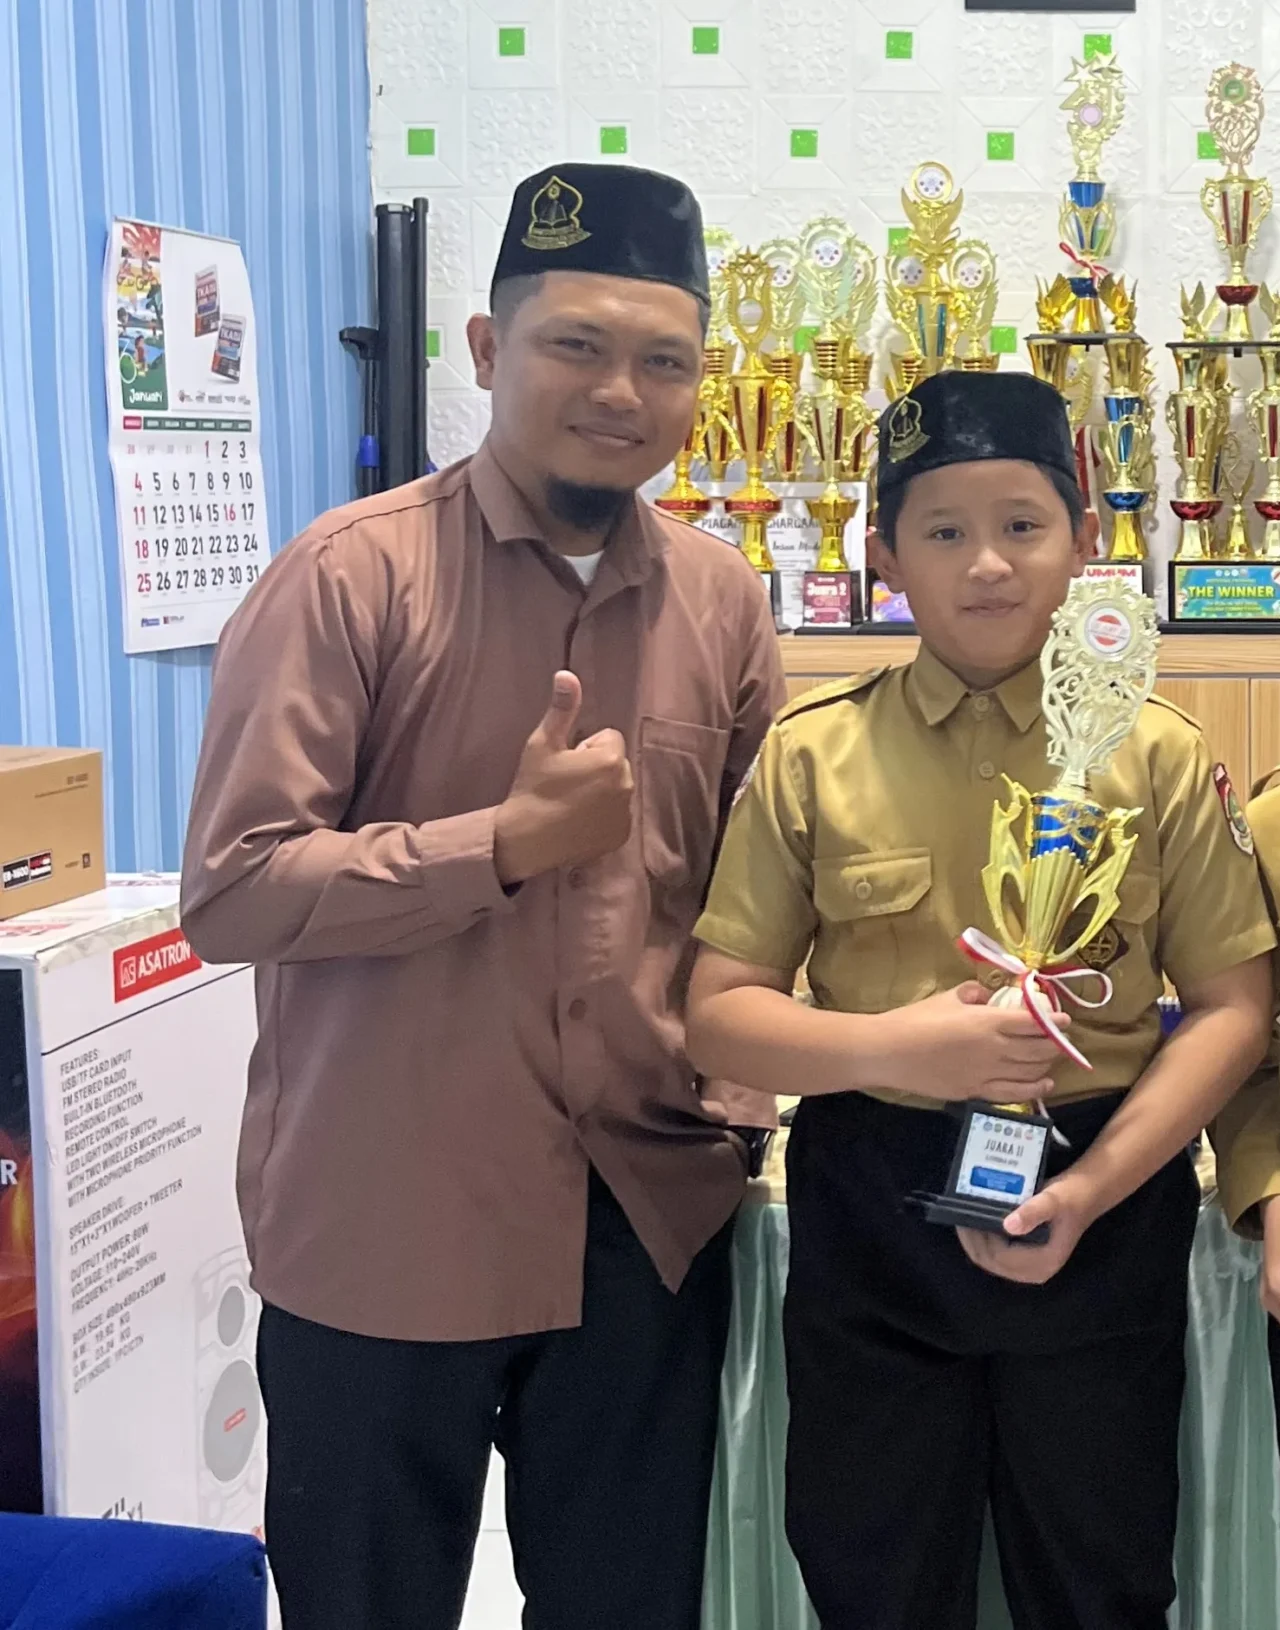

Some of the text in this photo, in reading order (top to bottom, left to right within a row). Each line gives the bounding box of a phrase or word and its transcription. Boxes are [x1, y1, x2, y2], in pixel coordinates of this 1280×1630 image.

[204, 440, 210, 459] 1
[221, 440, 229, 459] 2
[239, 440, 247, 459] 3
[134, 471, 253, 492] 4 5 6 7 8 9 10
[133, 502, 255, 526] 11 12 13 14 15 16 17
[135, 533, 258, 560] 18 19 20 21 22 23 24
[137, 564, 260, 593] 25 26 27 28 29 30 31
[839, 582, 848, 596] 2
[1188, 585, 1275, 598] THE WINNER
[138, 940, 191, 979] ASATRON
[89, 1059, 110, 1080] CARD
[111, 1048, 132, 1069] INPUT
[62, 1068, 127, 1110] FM STEREO RADIO
[94, 1079, 137, 1110] BLUETOOTH
[64, 1091, 144, 1141] RECORDING FUNCTION
[65, 1115, 129, 1158] REMOTE CONTROL
[66, 1158, 80, 1176] LED
[80, 1145, 101, 1168] LIGHT
[129, 1115, 158, 1140] SWITCH
[984, 1139, 1025, 1157] JUARA II
[67, 1116, 186, 1192] WITH TWO WIRELESS MICROPHONE
[68, 1123, 202, 1209] WITH MICROPHONE PRIORITY FUNCTION
[149, 1178, 183, 1206] TWEETER
[69, 1210, 101, 1240] SPEAKER
[70, 1251, 100, 1283] OUTPUT
